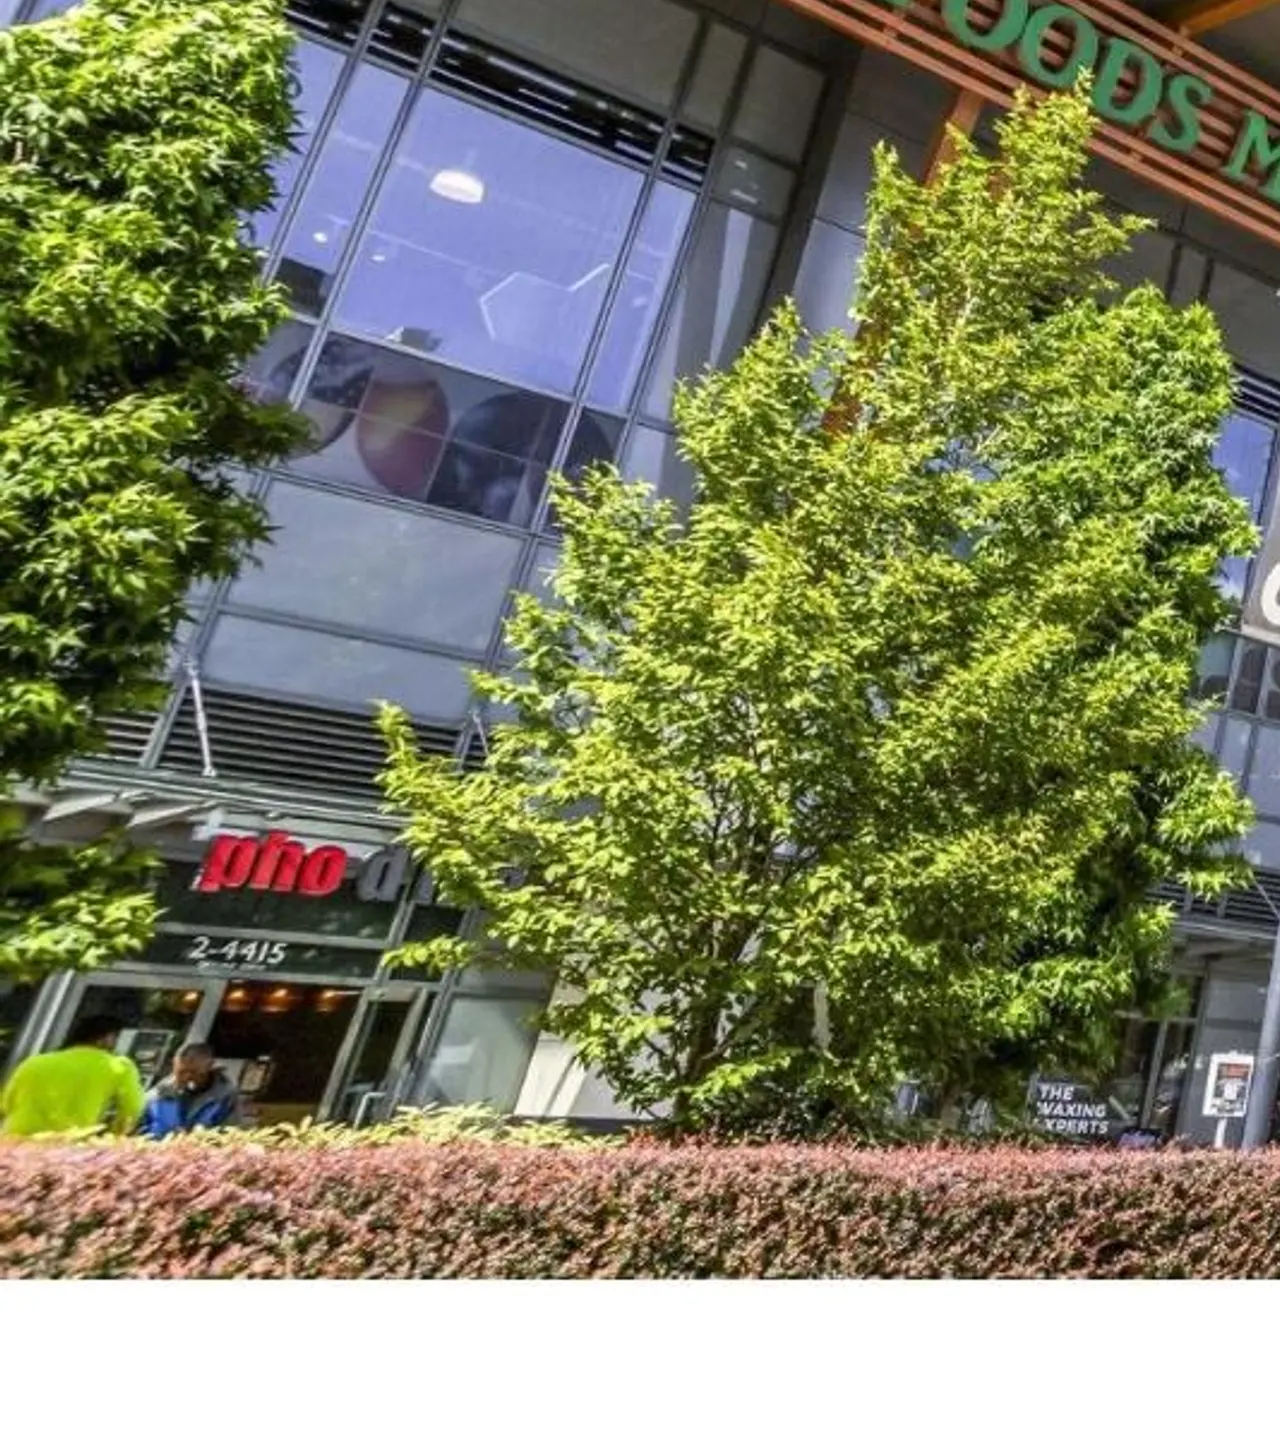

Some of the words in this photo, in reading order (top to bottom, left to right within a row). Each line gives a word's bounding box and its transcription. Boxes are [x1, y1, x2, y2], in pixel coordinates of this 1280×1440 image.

[200, 828, 348, 897] pho
[188, 935, 288, 964] 2-4415
[1039, 1084, 1074, 1101] THE
[1037, 1101, 1107, 1118] WAXING
